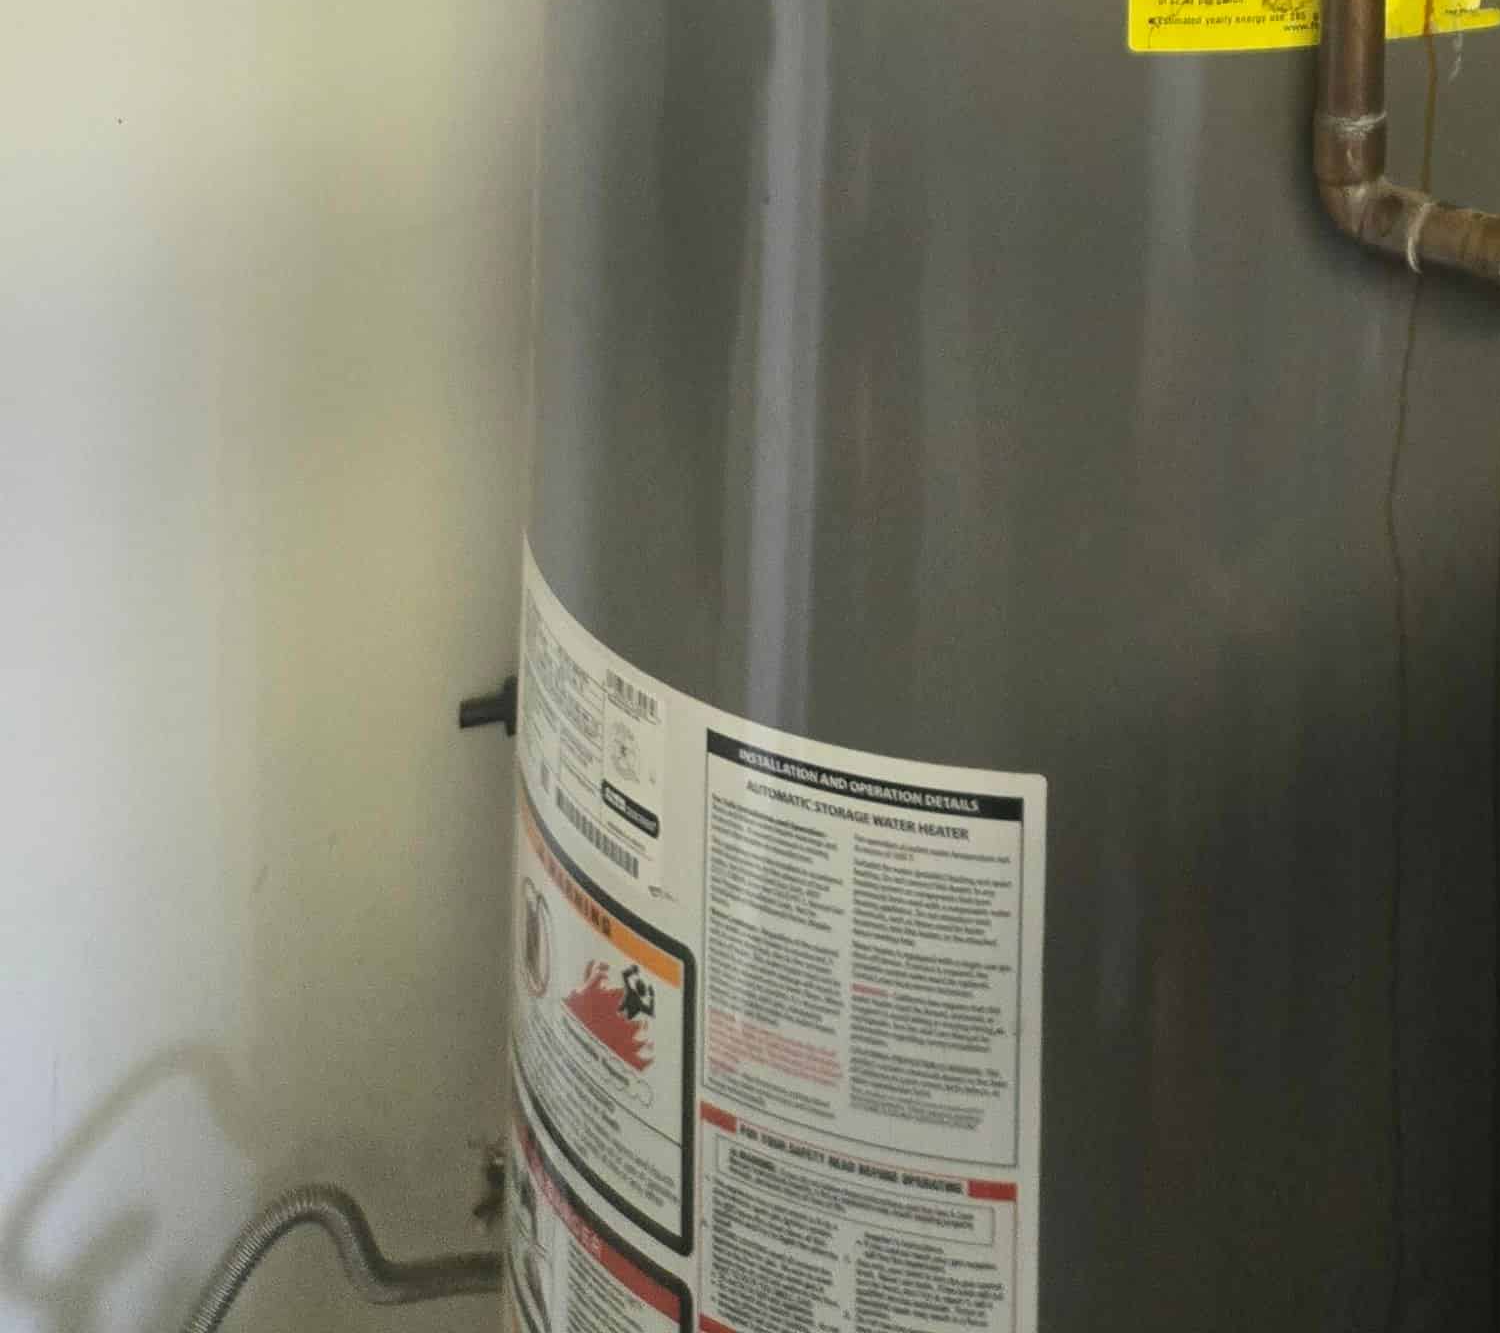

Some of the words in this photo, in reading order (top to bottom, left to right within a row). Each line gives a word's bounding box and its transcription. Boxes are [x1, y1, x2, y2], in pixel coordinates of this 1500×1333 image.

[737, 747, 819, 783] INSTALLATION
[817, 772, 848, 790] AND
[850, 780, 924, 807] OPERATION
[924, 793, 980, 813] DETAILS
[746, 778, 813, 812] AUTOMATIC
[812, 800, 872, 824] STORAGE
[872, 812, 916, 834] WATER
[917, 823, 970, 841] HEATER
